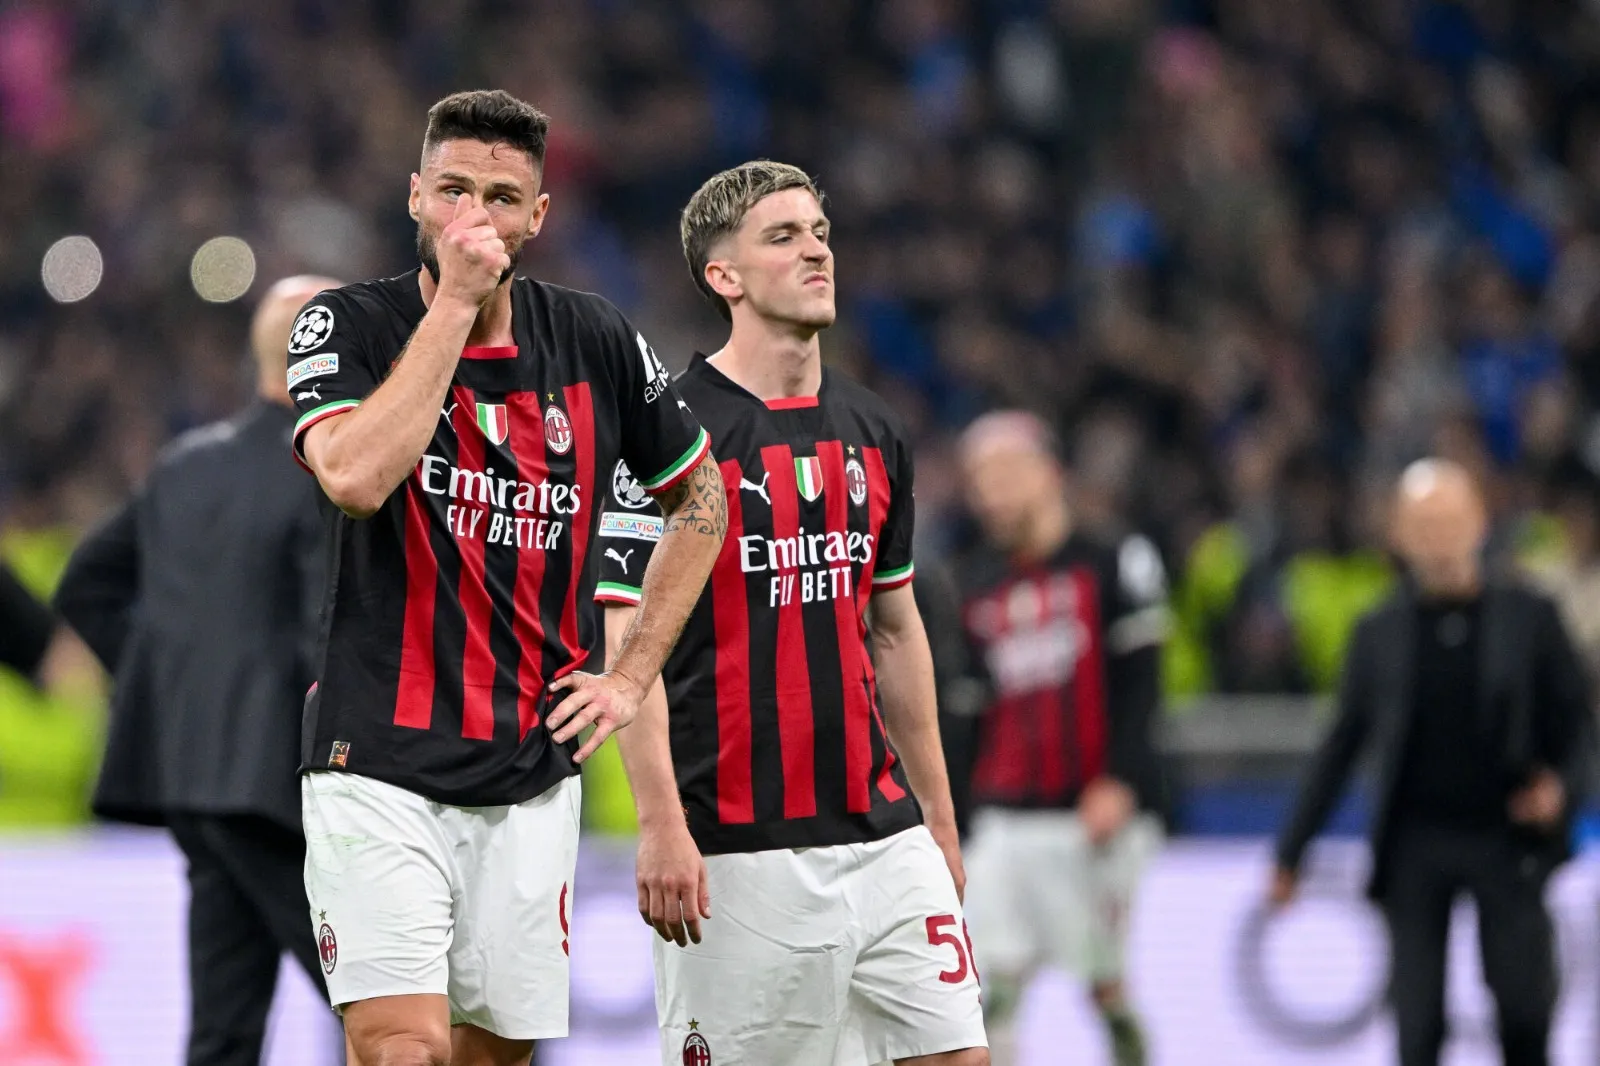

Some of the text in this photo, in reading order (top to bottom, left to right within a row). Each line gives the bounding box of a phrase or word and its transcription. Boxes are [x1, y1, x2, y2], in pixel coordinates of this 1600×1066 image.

[421, 454, 581, 515] Emirates
[446, 504, 564, 551] FLY BETTER
[601, 520, 663, 534] FOUNDATION
[737, 526, 874, 573] Emiraes
[801, 566, 852, 604] BETT
[925, 914, 981, 985] 5
